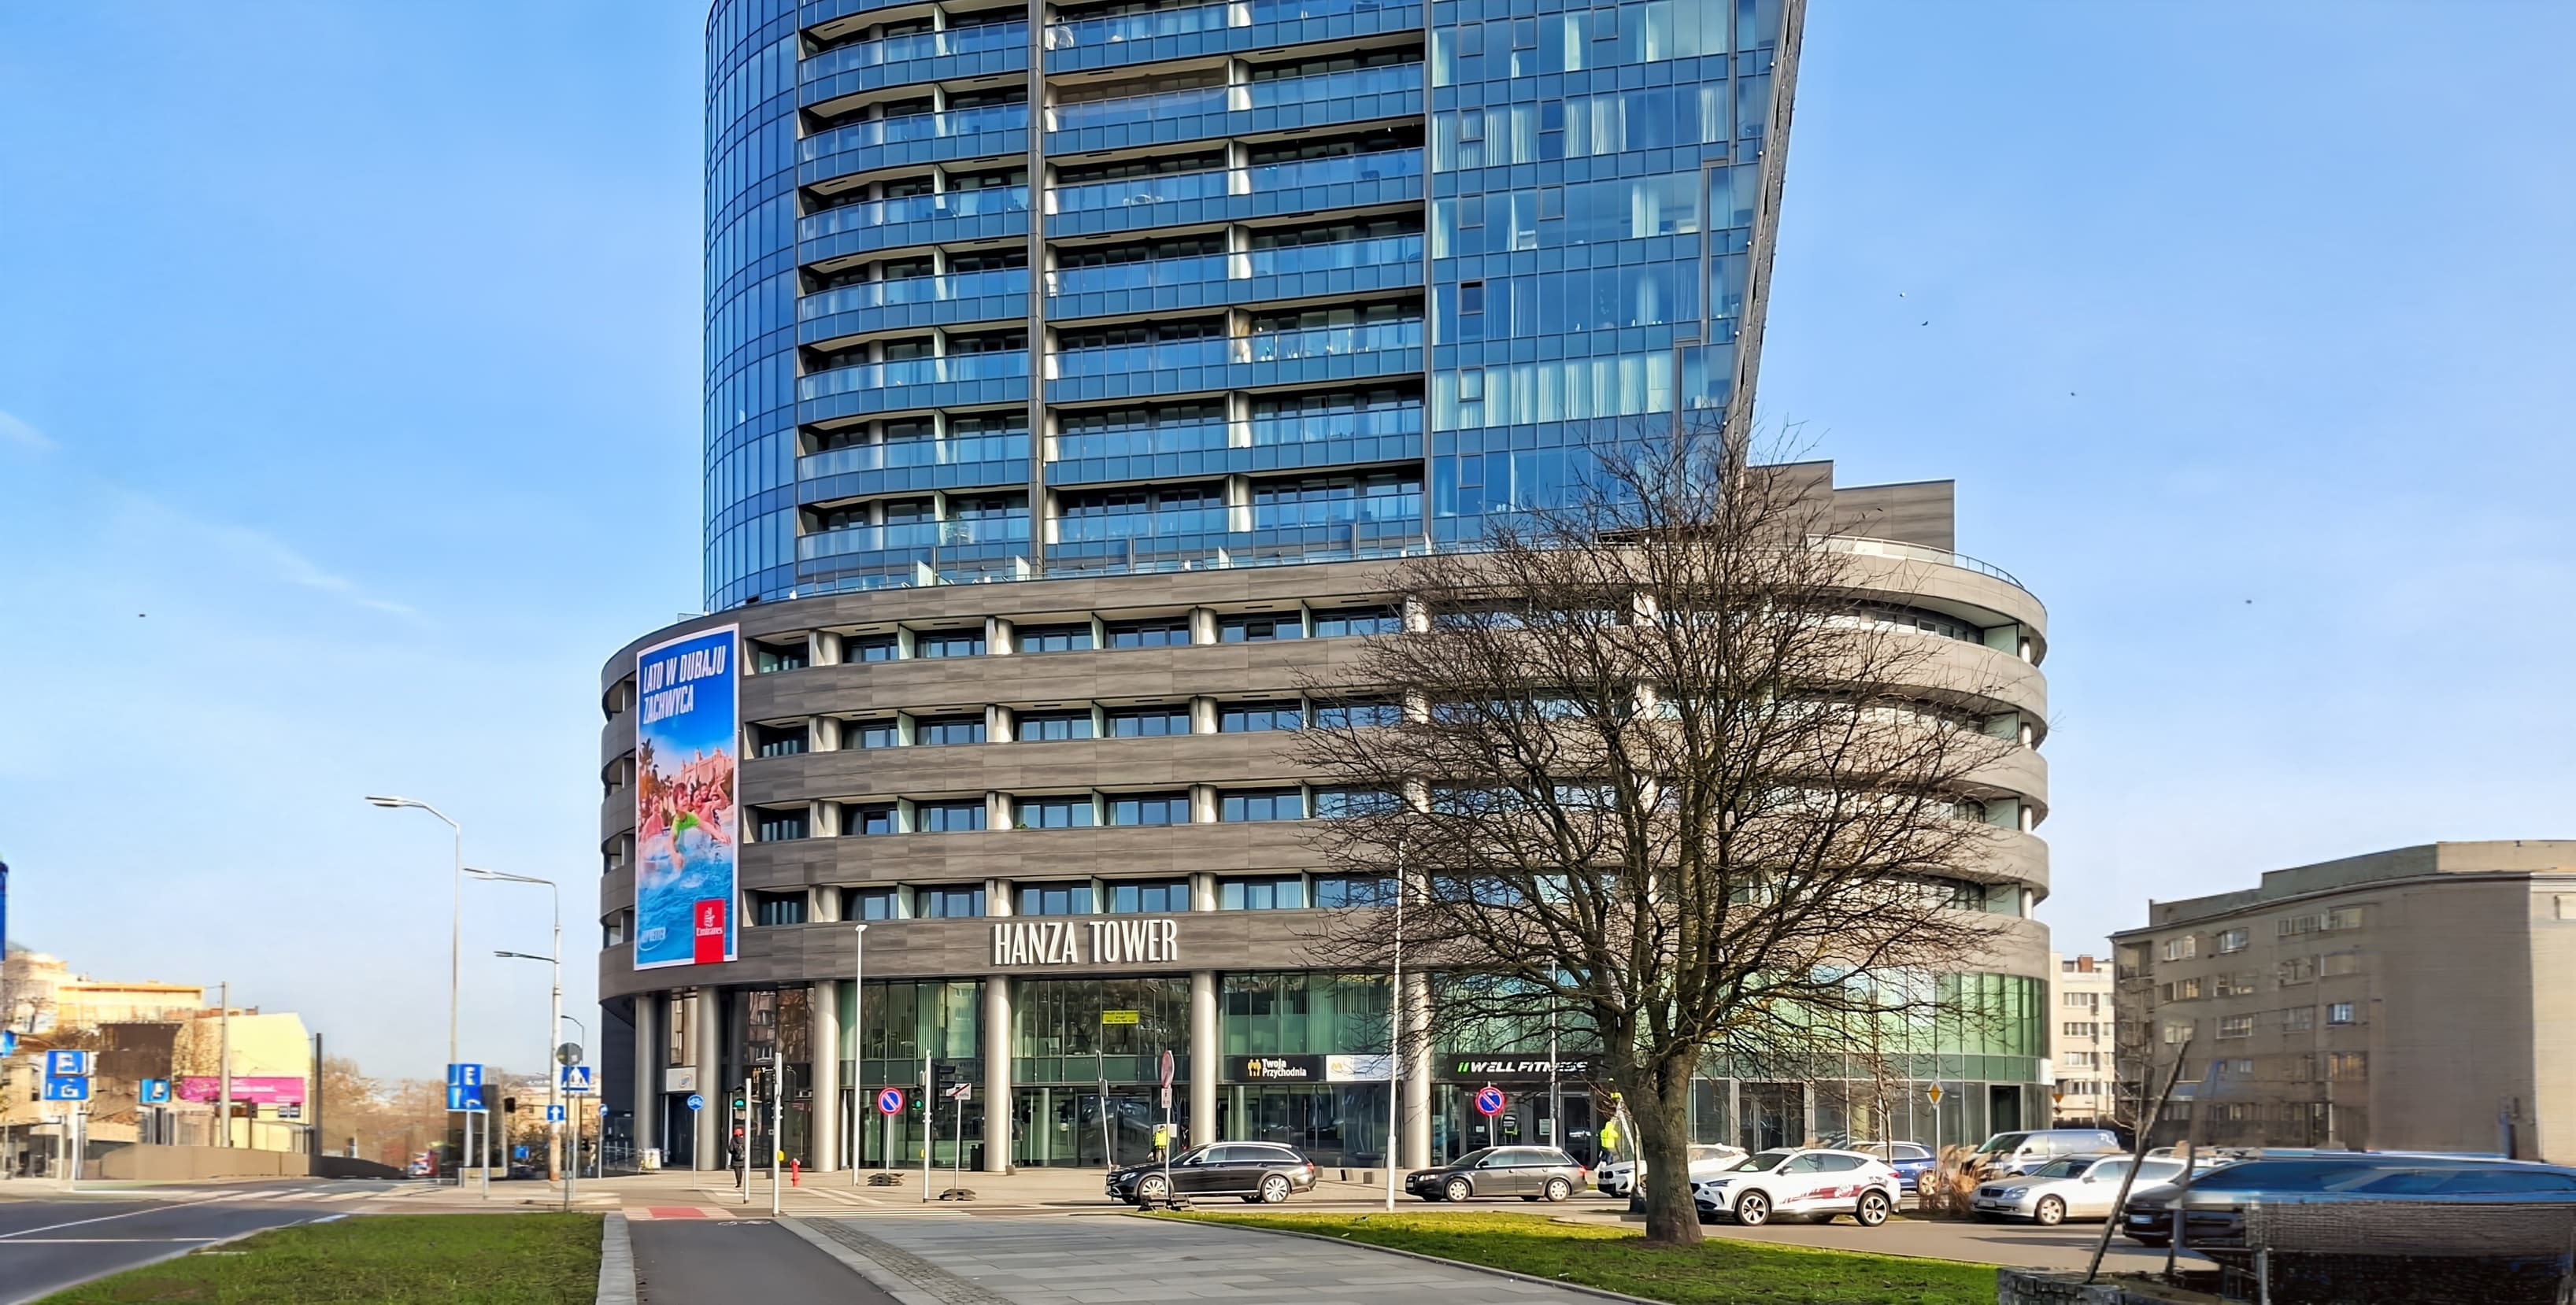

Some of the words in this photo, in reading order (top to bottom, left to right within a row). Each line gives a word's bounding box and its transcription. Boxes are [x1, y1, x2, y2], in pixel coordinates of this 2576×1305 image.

[643, 661, 664, 694] LATO
[666, 656, 678, 686] W
[679, 645, 726, 682] DUBAJU
[643, 684, 694, 725] ZACHWYCA
[994, 921, 1079, 965] HANZA
[1089, 919, 1179, 962] TOWER
[1261, 1058, 1287, 1069] Twoja
[1262, 1067, 1307, 1078] Przychodnia
[1471, 1062, 1516, 1072] WELL
